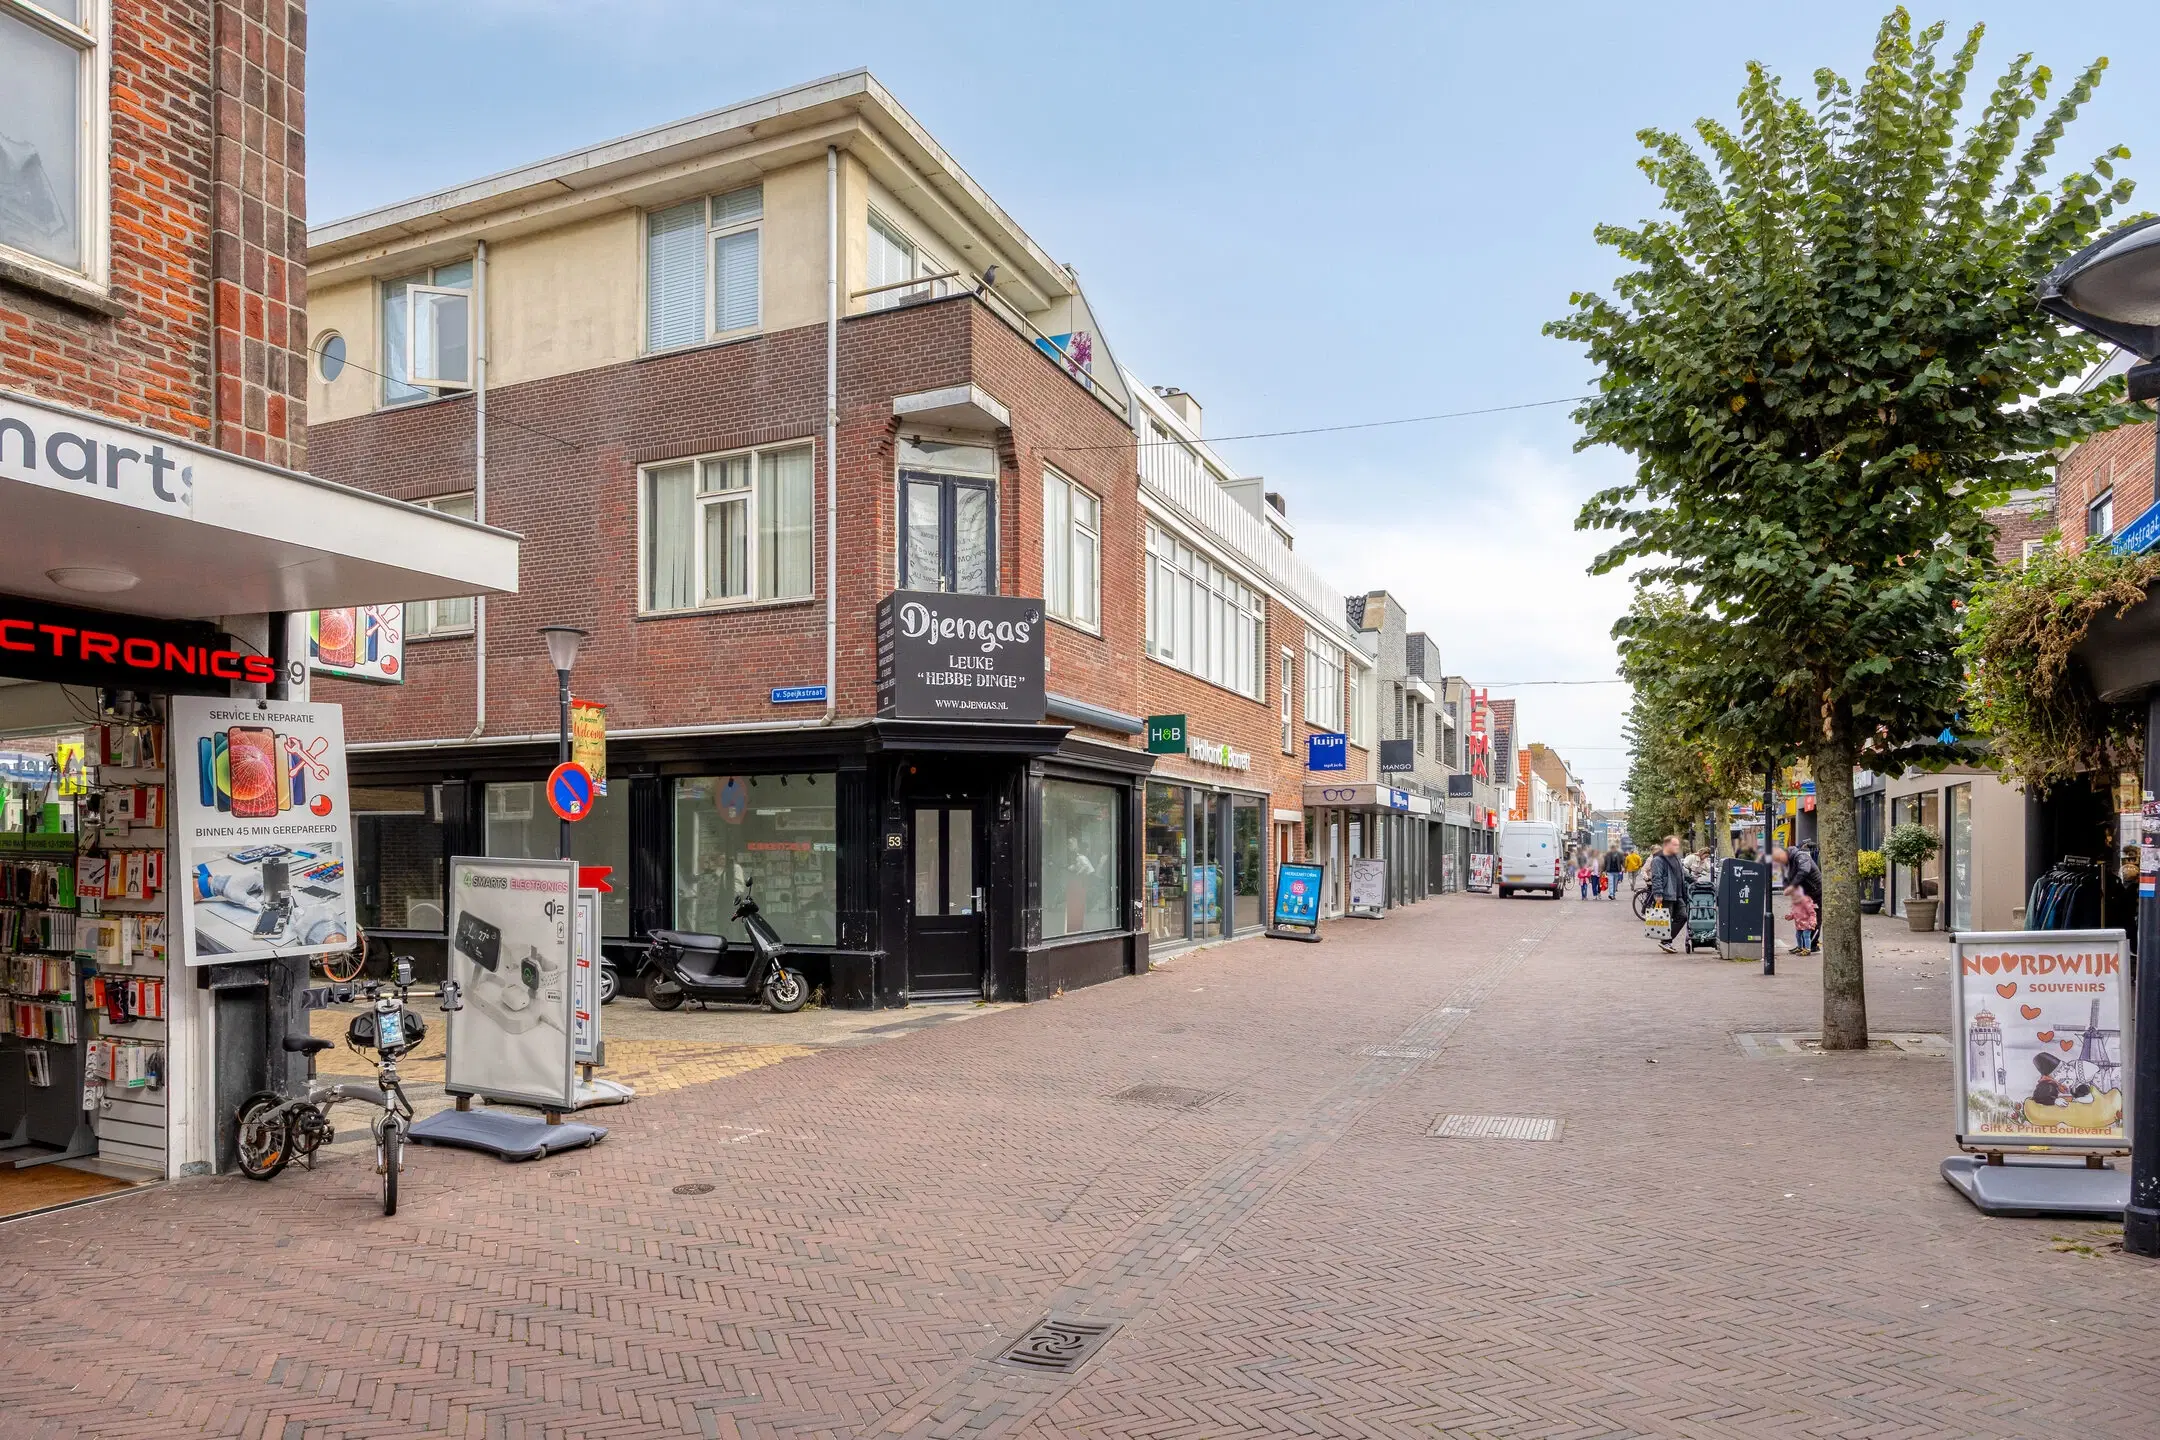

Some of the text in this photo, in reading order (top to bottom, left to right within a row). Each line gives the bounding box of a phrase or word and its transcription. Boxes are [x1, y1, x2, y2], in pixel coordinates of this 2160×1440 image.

[900, 602, 1030, 652] Djengas
[949, 655, 993, 670] LEUKE
[935, 699, 1008, 710] WWW.DJENGAS.NL
[209, 710, 315, 723] SERVICE EN REPARATIE
[573, 721, 605, 739] Welcome
[1469, 688, 1489, 778] HEMA
[1312, 736, 1343, 747] Tuijn
[196, 824, 337, 837] BINNEN 45 MIN GEREPAREERD
[888, 836, 901, 847] 53
[464, 872, 569, 893] 4 SMARTS ELECTRONICS
[2029, 983, 2106, 993] SOUVENIRS
[1980, 1123, 2112, 1136] Gift & Print Boulevard
